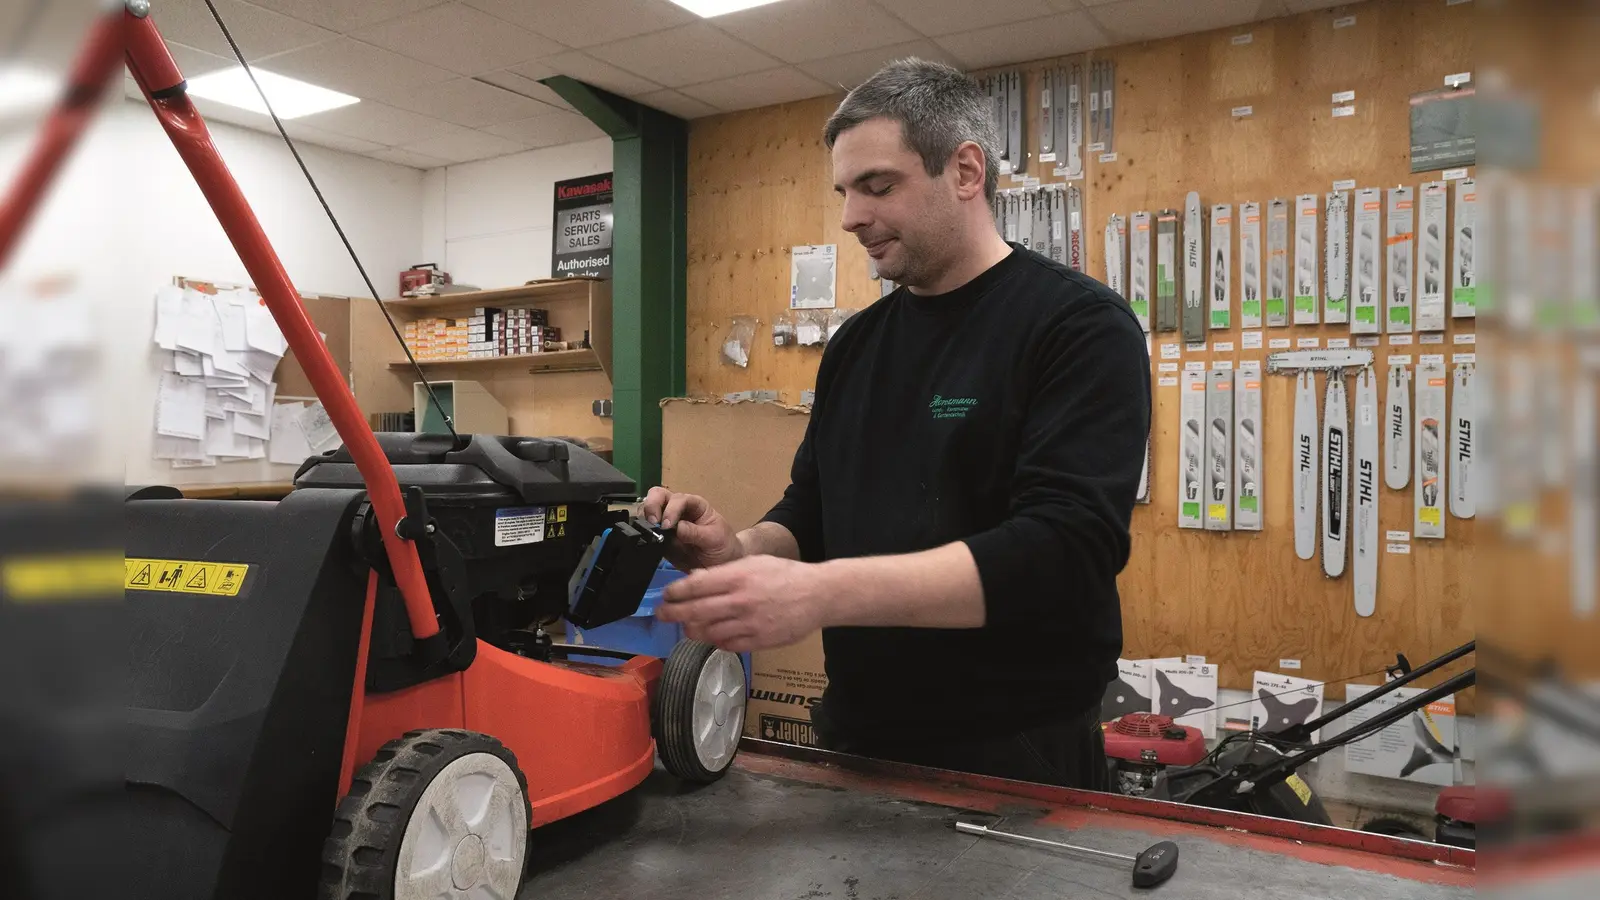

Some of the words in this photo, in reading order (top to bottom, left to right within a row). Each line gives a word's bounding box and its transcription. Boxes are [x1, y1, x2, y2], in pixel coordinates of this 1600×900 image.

[557, 178, 613, 199] Kawasak
[570, 210, 601, 223] PARTS
[564, 222, 606, 236] SERVICE
[569, 235, 600, 248] SALES
[1188, 238, 1197, 268] STIHL
[557, 254, 610, 271] Authorised
[1393, 404, 1403, 439] STIHL
[1458, 418, 1471, 462] STIHL
[1300, 434, 1310, 472] STIHL
[1330, 432, 1342, 474] STIHL
[1426, 449, 1434, 472] STIHL
[1360, 458, 1372, 506] STIHL
[1428, 704, 1451, 712] STIHL
